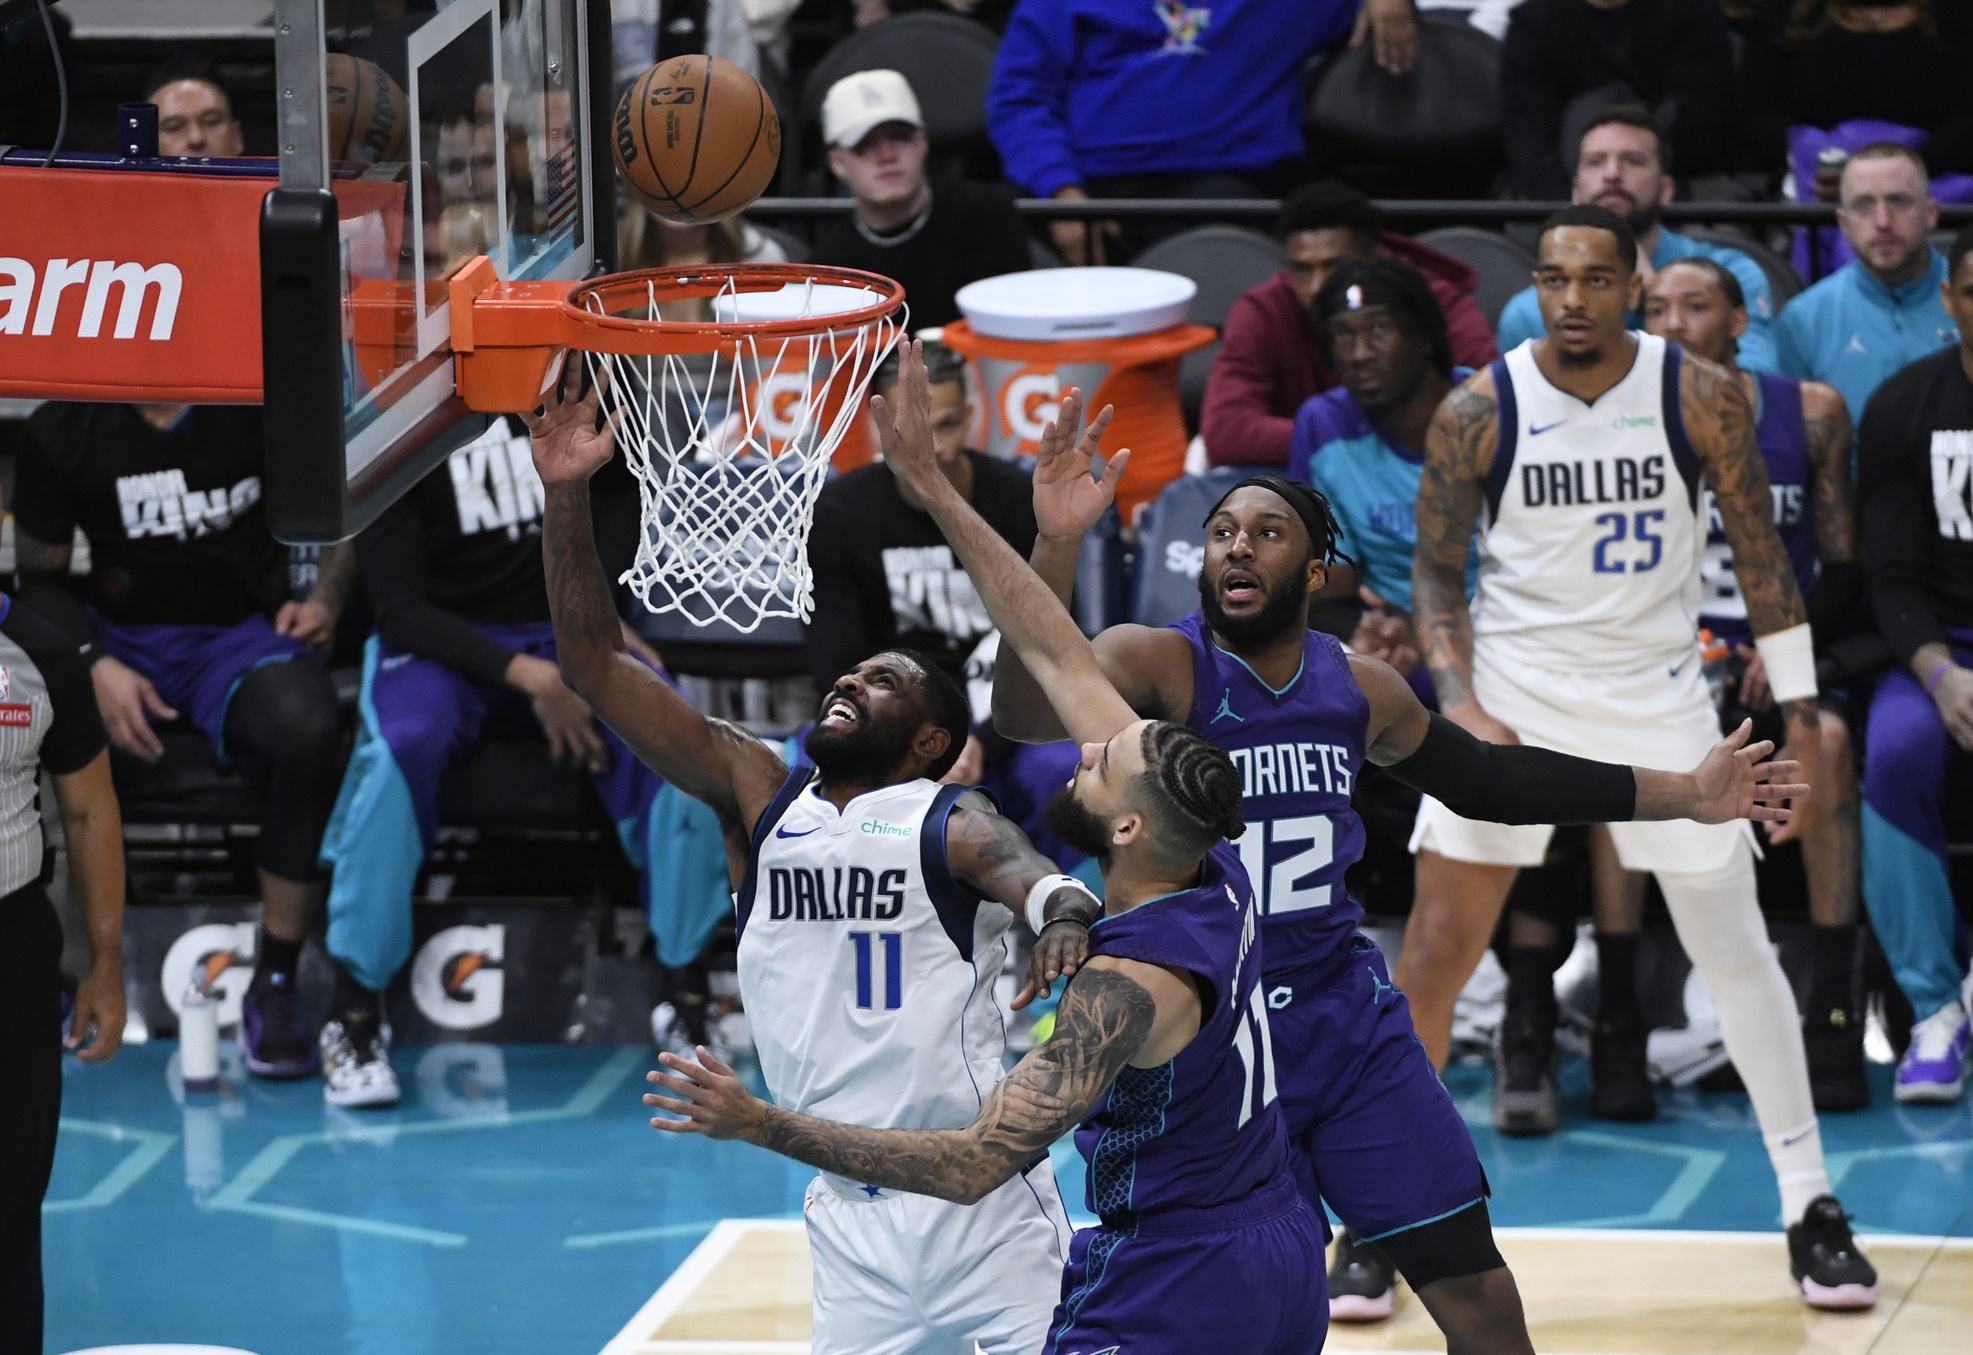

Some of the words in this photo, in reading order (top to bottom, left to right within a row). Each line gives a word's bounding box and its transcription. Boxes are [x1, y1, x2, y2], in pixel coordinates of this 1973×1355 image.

[1006, 374, 1060, 441] G
[1612, 414, 1656, 430] chime
[1522, 455, 1665, 508] DALLAS
[1593, 509, 1665, 573] 25
[1228, 742, 1353, 798] ORNETS
[861, 819, 913, 836] chime
[769, 865, 908, 922] DALLAS
[1230, 813, 1334, 917] 12
[161, 922, 256, 1030] G
[411, 924, 505, 1029] G
[848, 930, 903, 1011] 11
[1231, 977, 1279, 1132] 11
